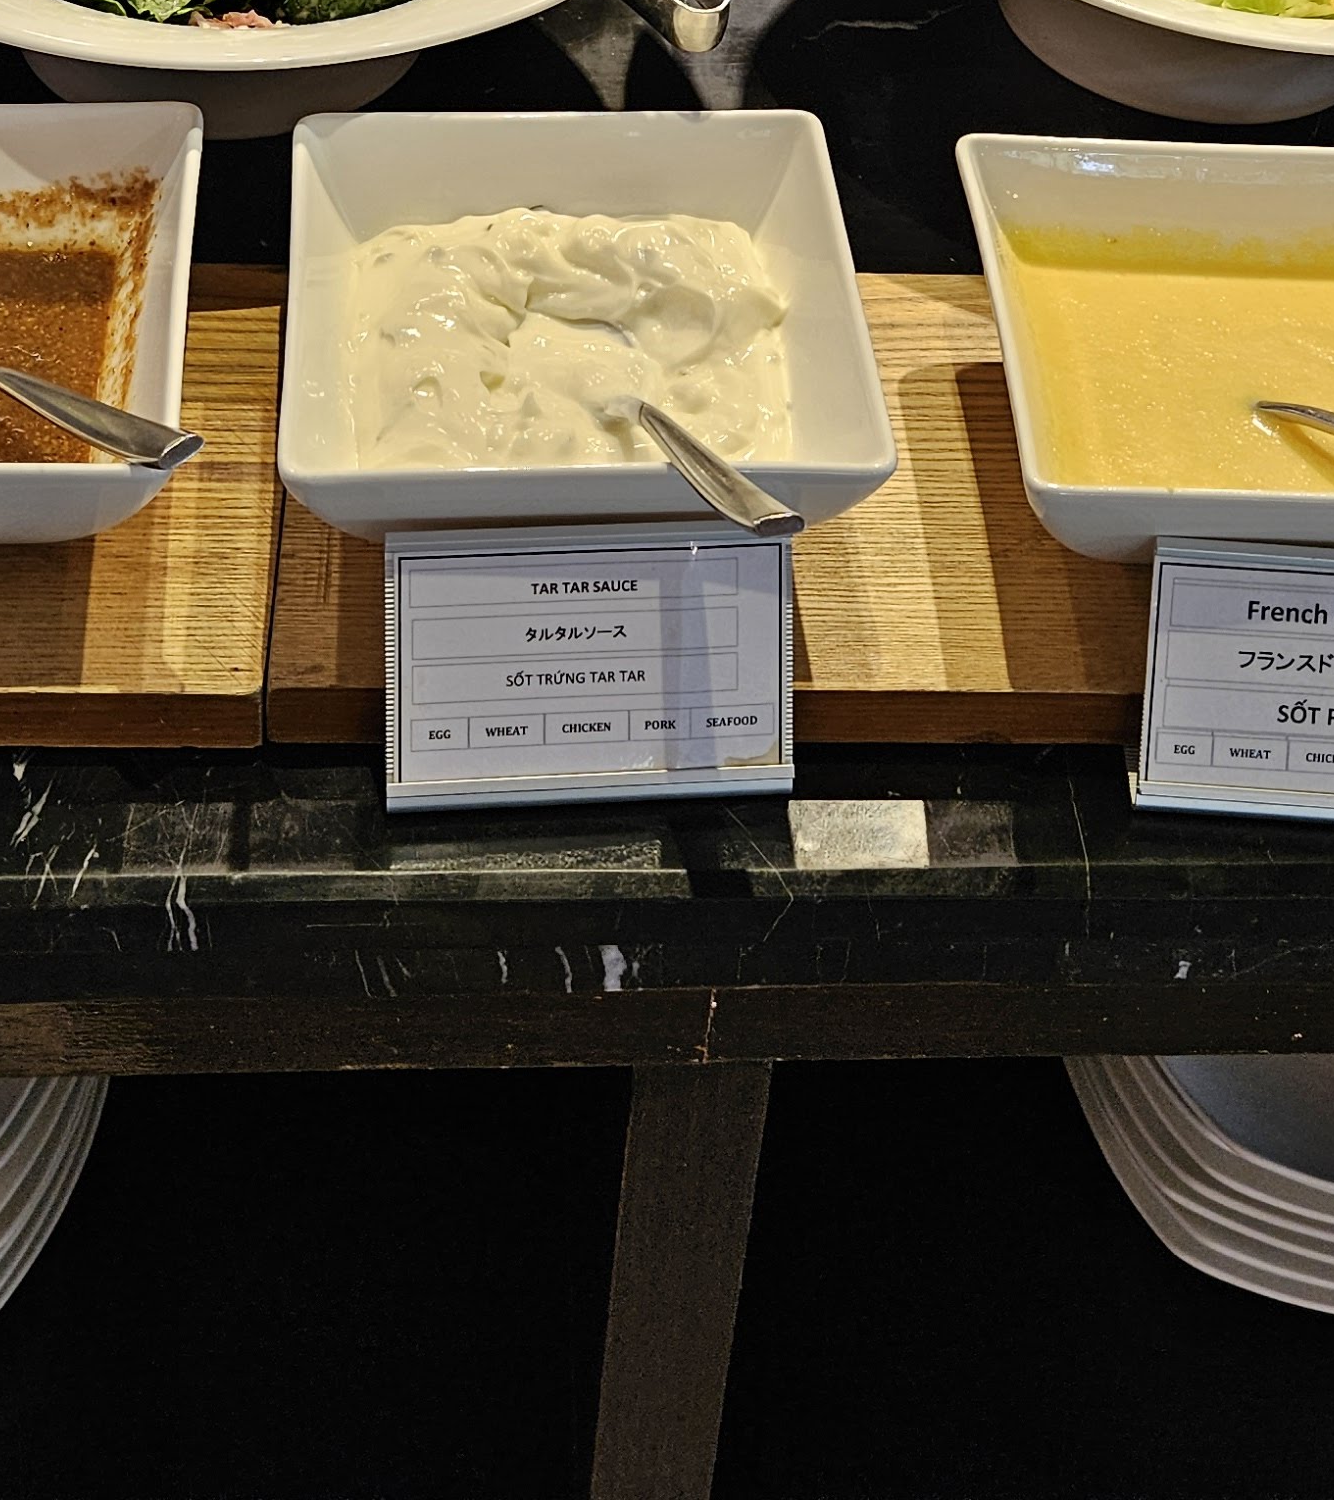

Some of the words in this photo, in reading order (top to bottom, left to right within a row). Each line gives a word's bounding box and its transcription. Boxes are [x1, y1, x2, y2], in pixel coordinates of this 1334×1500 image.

[531, 582, 559, 595] TAR
[562, 581, 590, 594] TAR
[593, 579, 638, 593] SAUCE
[1247, 600, 1328, 626] French
[525, 625, 627, 642] タルタルソース
[506, 670, 533, 687] SỐT
[536, 670, 586, 686] TRỨNG
[590, 670, 616, 684] TAR
[619, 669, 646, 683] TAR
[1277, 699, 1321, 725] SỐT
[428, 728, 451, 740] EGG
[486, 725, 528, 738] WHEAT
[562, 722, 611, 734] CHICKEN
[644, 719, 676, 731] PORK
[706, 714, 758, 728] SEAFOOD
[1174, 744, 1195, 755] EGG
[1229, 747, 1271, 760] WHEAT
